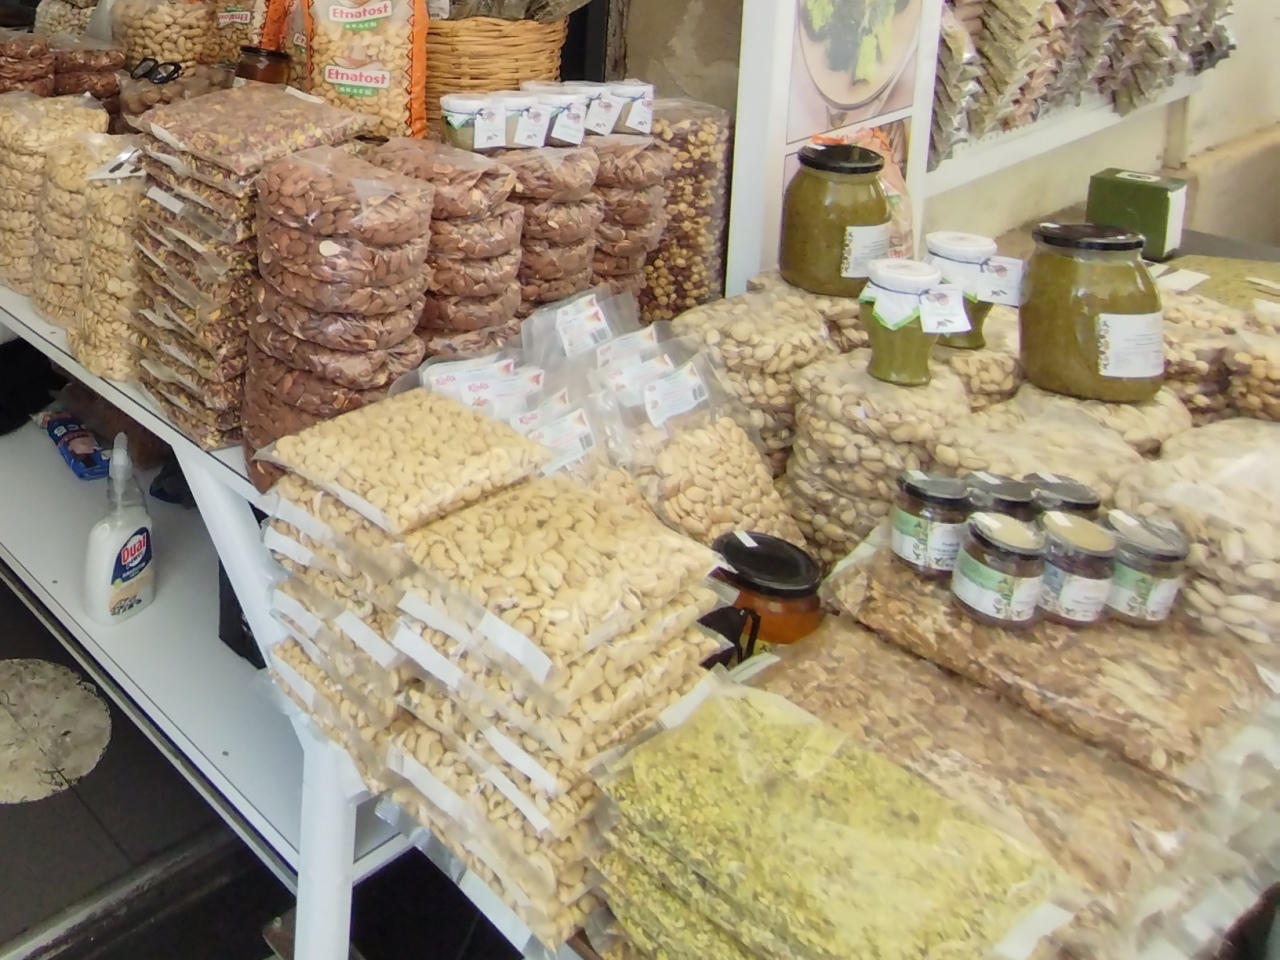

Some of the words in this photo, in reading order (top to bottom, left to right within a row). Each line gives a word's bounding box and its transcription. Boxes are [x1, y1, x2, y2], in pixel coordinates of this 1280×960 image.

[332, 3, 389, 20] Etnatost
[327, 68, 387, 85] Etnatost
[120, 532, 147, 565] Dual
